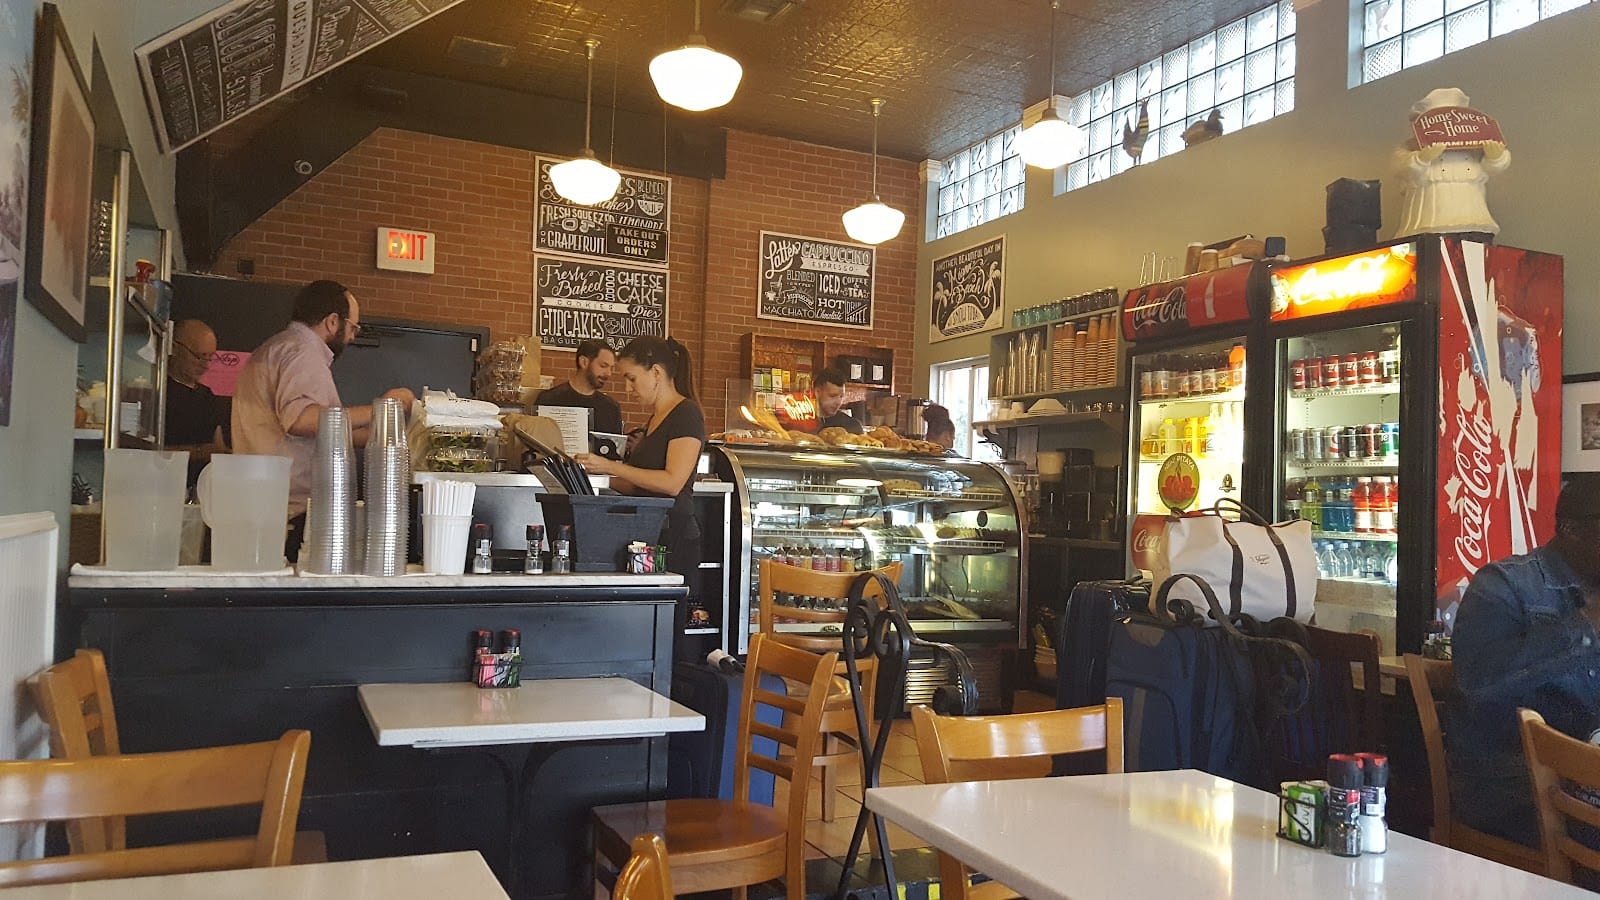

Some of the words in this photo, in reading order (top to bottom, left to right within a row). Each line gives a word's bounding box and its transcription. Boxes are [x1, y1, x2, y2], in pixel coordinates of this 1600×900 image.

[1420, 111, 1452, 130] Home
[1451, 109, 1491, 126] Sweet
[1443, 121, 1480, 137] Home
[541, 204, 571, 229] FRESH
[561, 217, 595, 233] OJ
[547, 230, 605, 255] GRAPEFRUIT
[613, 226, 639, 238] TAKE
[641, 231, 661, 241] OUT
[616, 236, 657, 249] ORDERS
[388, 231, 427, 261] EXIT
[624, 246, 649, 257] ONLY
[801, 241, 871, 266] CAPPUCCINO
[764, 240, 801, 279] Lattes
[538, 262, 593, 288] Fresh
[617, 271, 664, 290] CHEESE
[786, 269, 815, 282] BLENDED
[819, 273, 840, 296] ICED
[551, 271, 604, 299] Baked
[616, 286, 663, 307] CAKE
[848, 287, 863, 298] TEA
[557, 300, 614, 311] COOKIES
[631, 305, 663, 319] Pies
[763, 305, 815, 318] MACCHIATO
[818, 298, 844, 309] HOT
[1132, 286, 1187, 329] Coca-Cola
[539, 308, 605, 340] CUPCAKES
[1455, 405, 1492, 575] Coca-Cola
